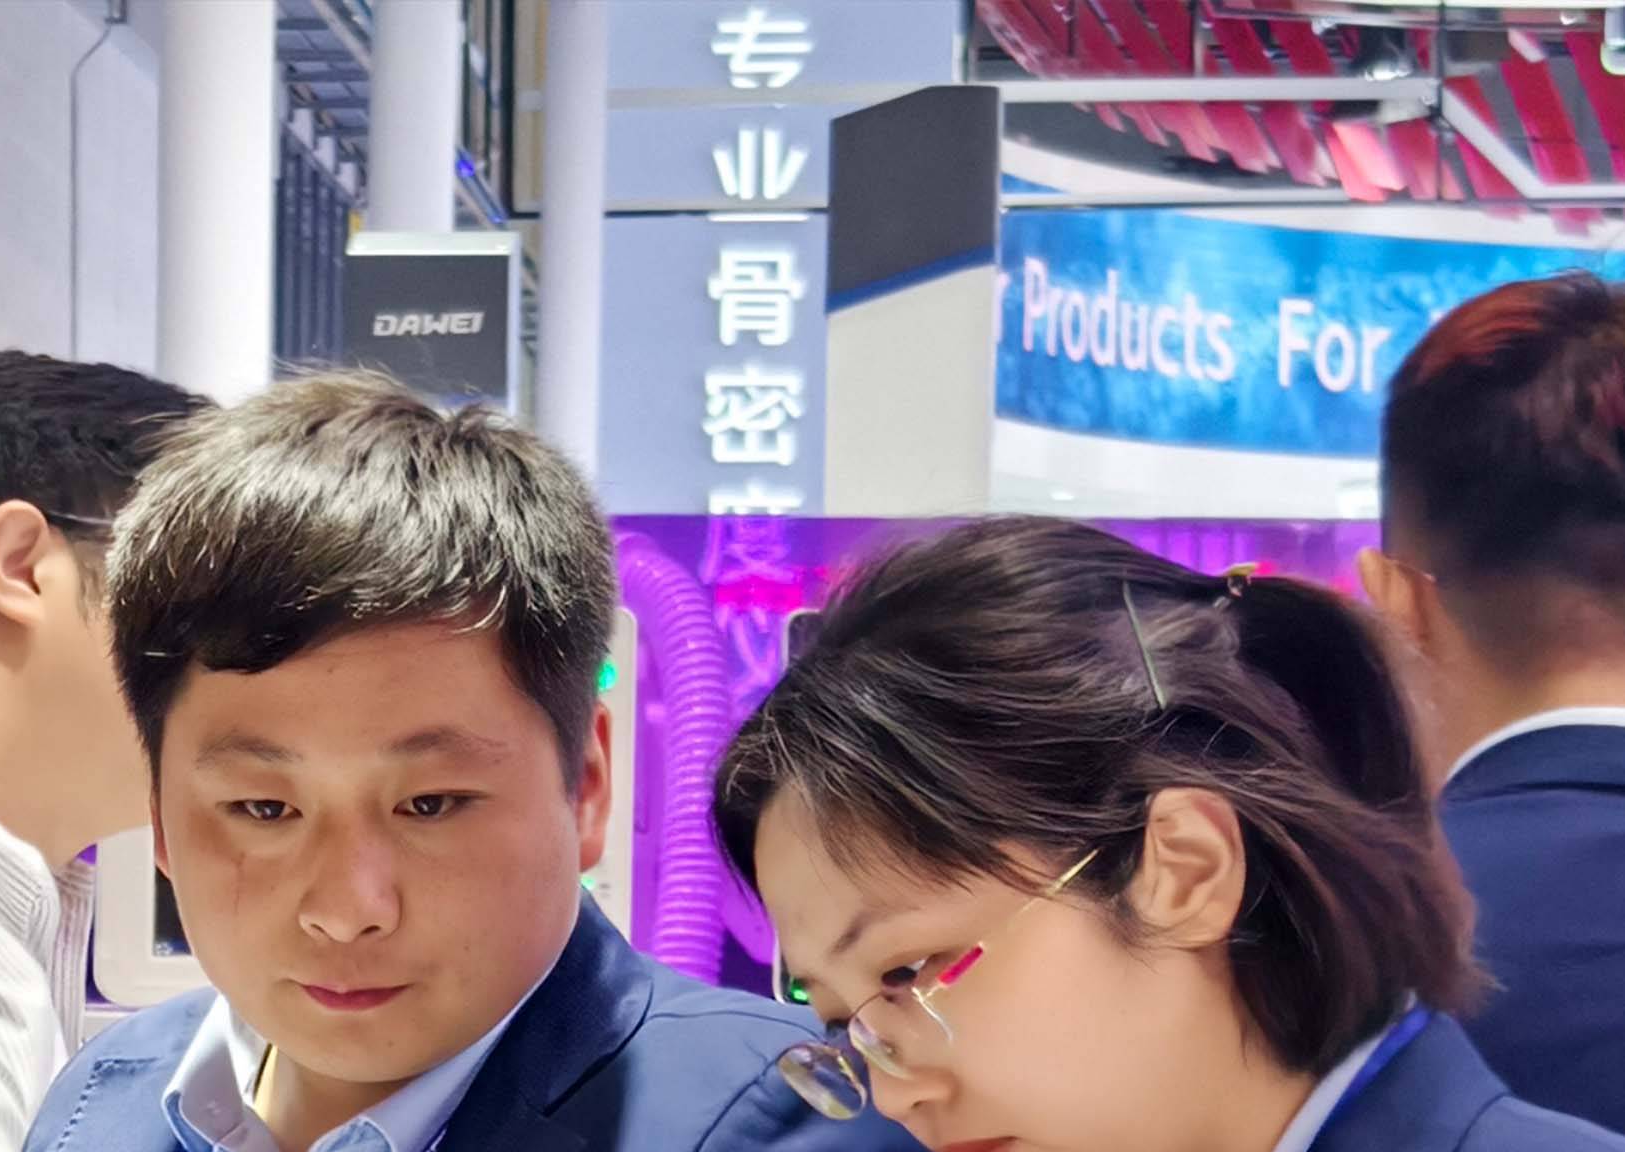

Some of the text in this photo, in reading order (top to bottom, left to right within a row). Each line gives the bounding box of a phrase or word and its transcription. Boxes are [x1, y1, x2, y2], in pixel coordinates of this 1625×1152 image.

[372, 311, 485, 337] DAWEI
[1022, 256, 1235, 383] Products
[1276, 297, 1392, 395] For
